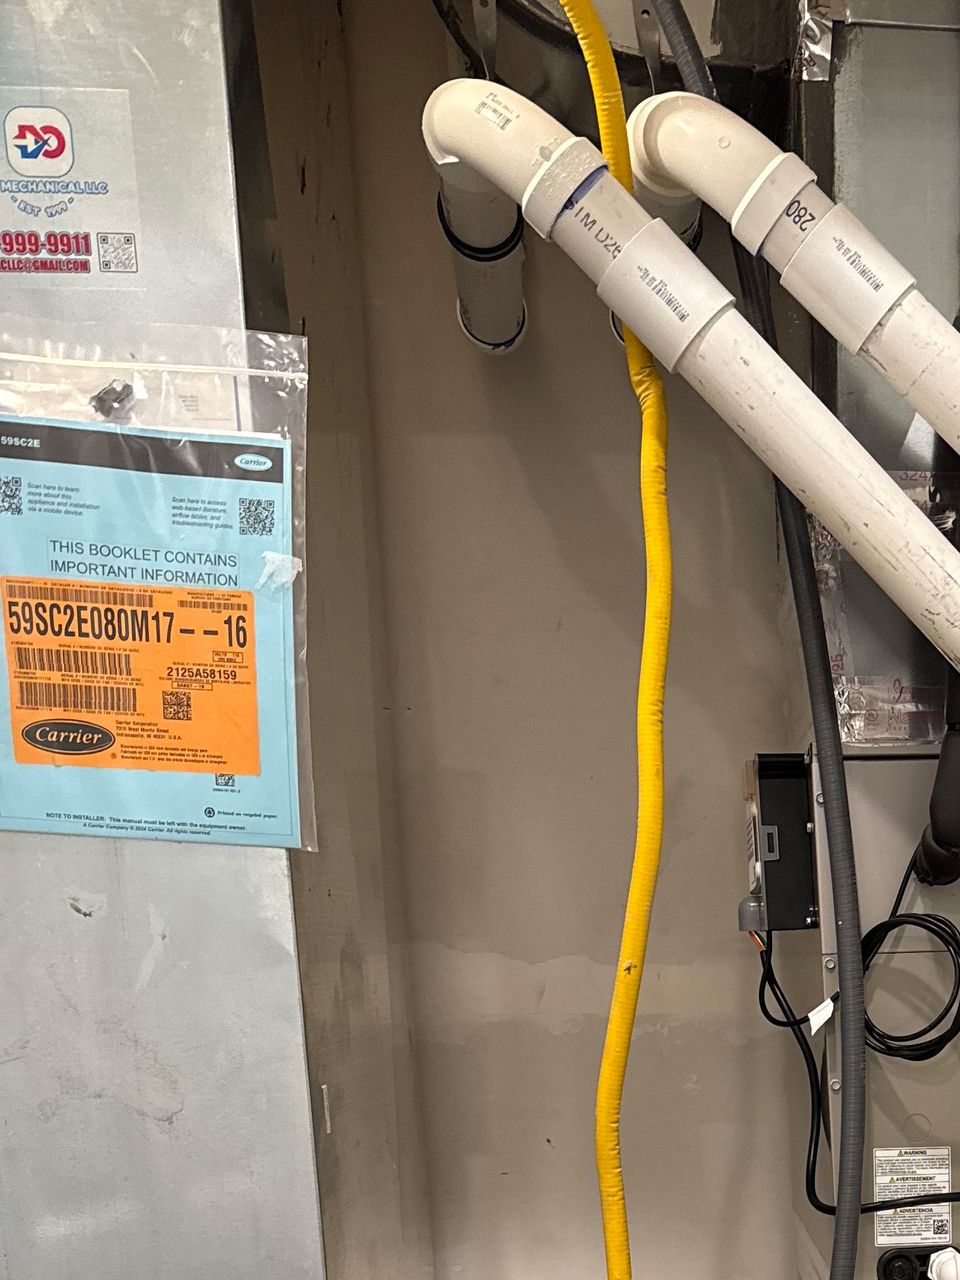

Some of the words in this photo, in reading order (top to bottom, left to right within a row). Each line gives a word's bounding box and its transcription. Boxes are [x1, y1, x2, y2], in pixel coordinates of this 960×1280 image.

[85, 182, 109, 194] LLC
[18, 201, 41, 217] EST
[785, 200, 816, 232] 280
[0, 231, 92, 256] 999-9911
[1, 436, 40, 447] 59SC2E
[240, 458, 267, 466] Carrier
[69, 501, 100, 510] installation
[50, 540, 84, 555] THIS
[89, 544, 161, 562] BOOKLET
[164, 550, 238, 567] CONTAINS
[50, 560, 137, 579] IMPORTANT
[141, 568, 238, 586] INFORMATION
[167, 667, 237, 680] 2125A58159
[35, 727, 103, 746] Carrier
[73, 814, 105, 822] INSTALLER:
[199, 823, 228, 831] equipment
